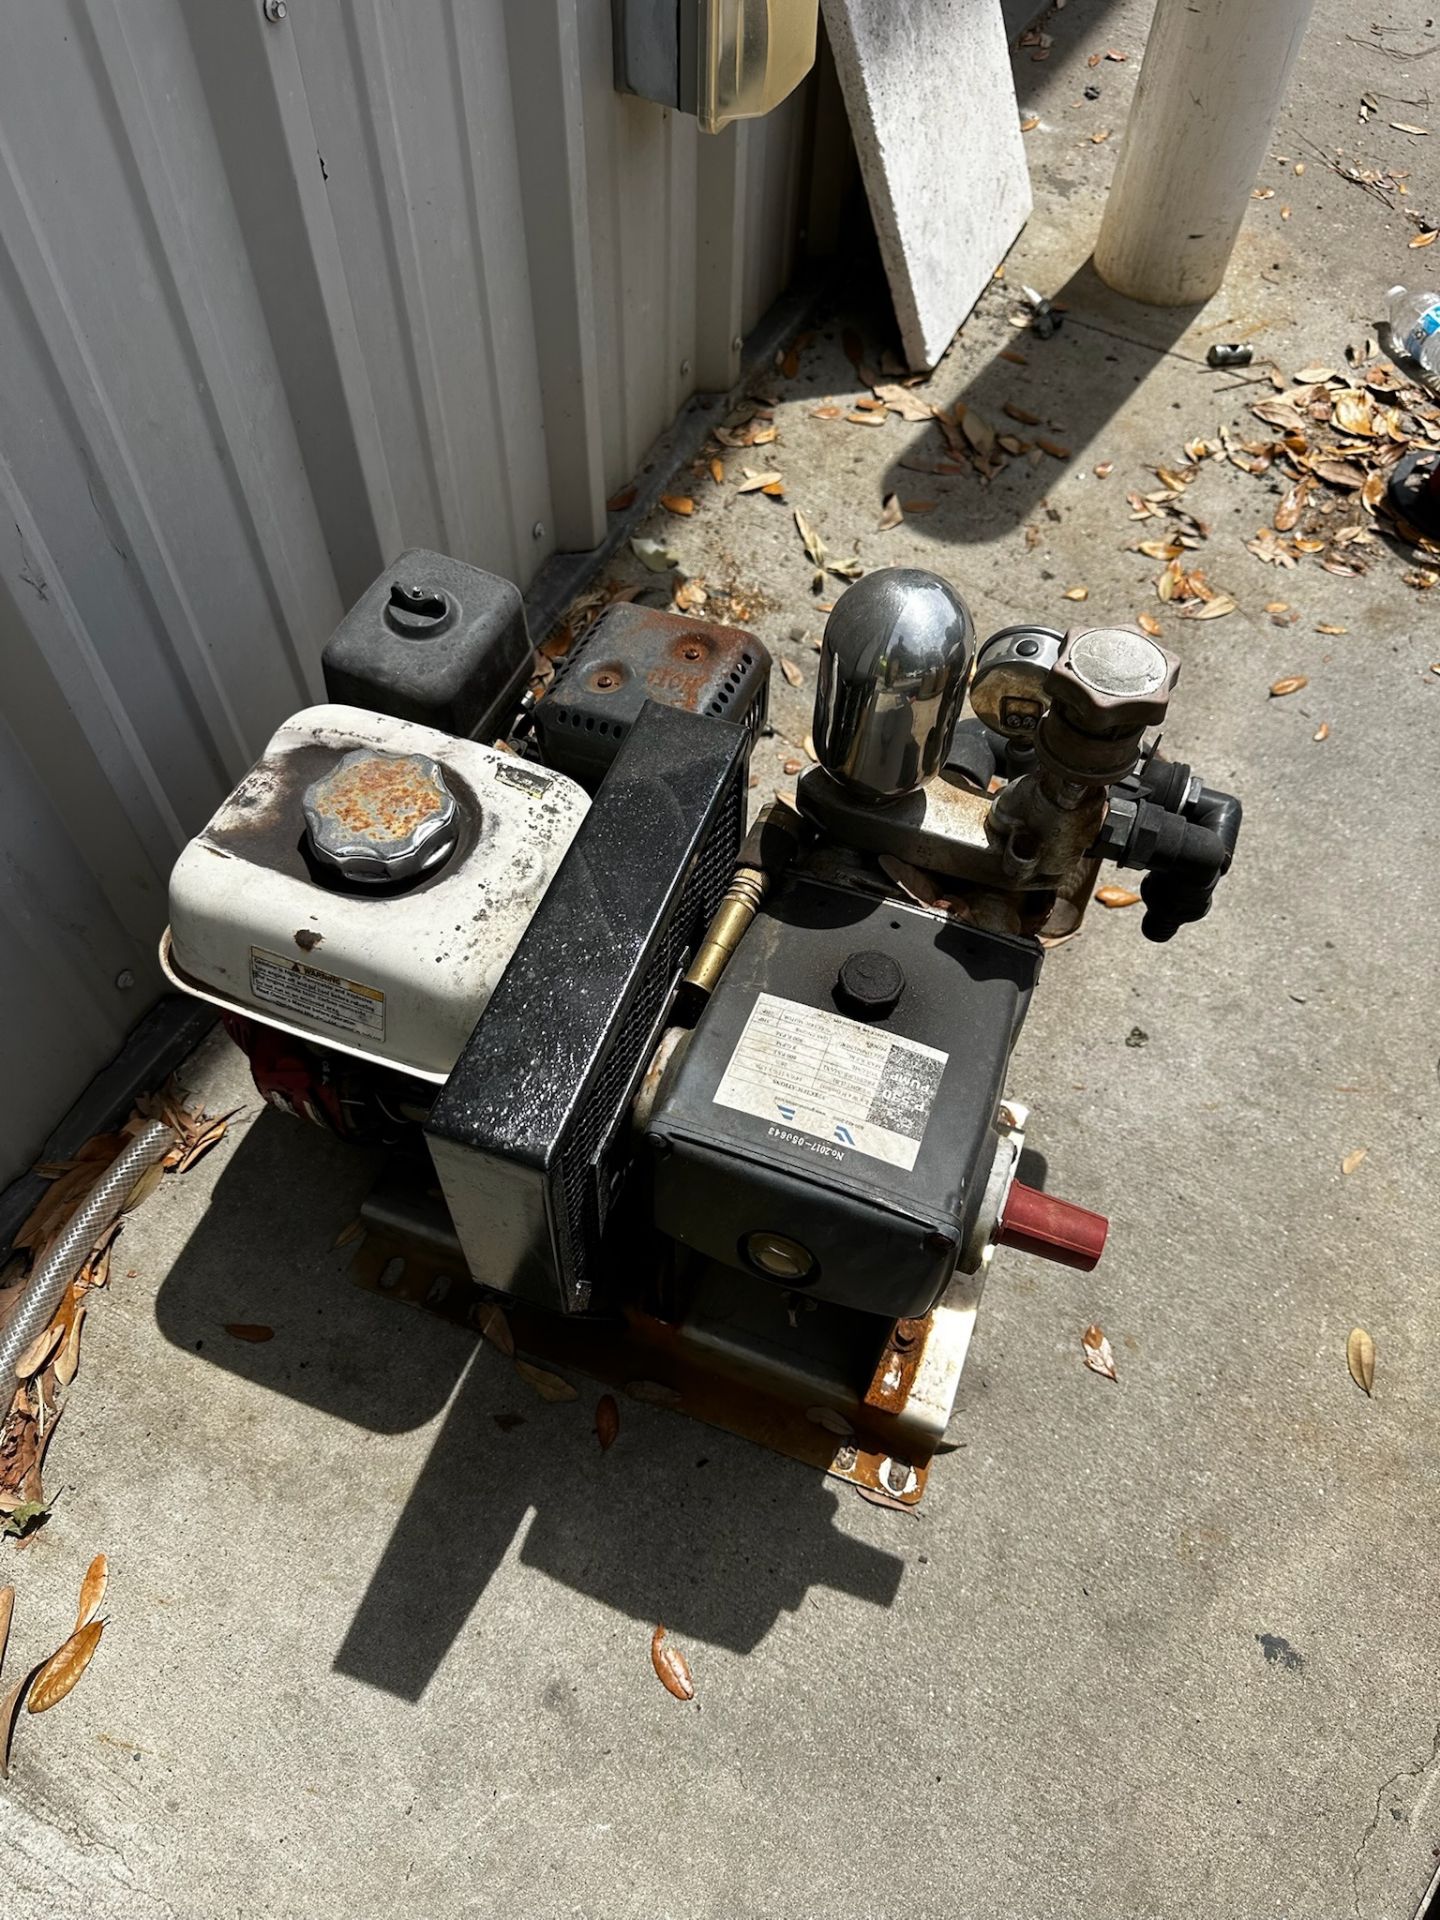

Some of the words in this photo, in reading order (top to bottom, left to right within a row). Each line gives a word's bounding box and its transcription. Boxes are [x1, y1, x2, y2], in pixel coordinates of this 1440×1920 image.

[266, 977, 284, 987] engine
[267, 970, 285, 980] engine
[284, 969, 301, 980] highly
[304, 966, 340, 985] WARNING
[256, 986, 269, 994] Read
[312, 1006, 329, 1017] before
[771, 1077, 826, 1101] SPECIFICATIONS
[888, 1071, 930, 1092] PUMP
